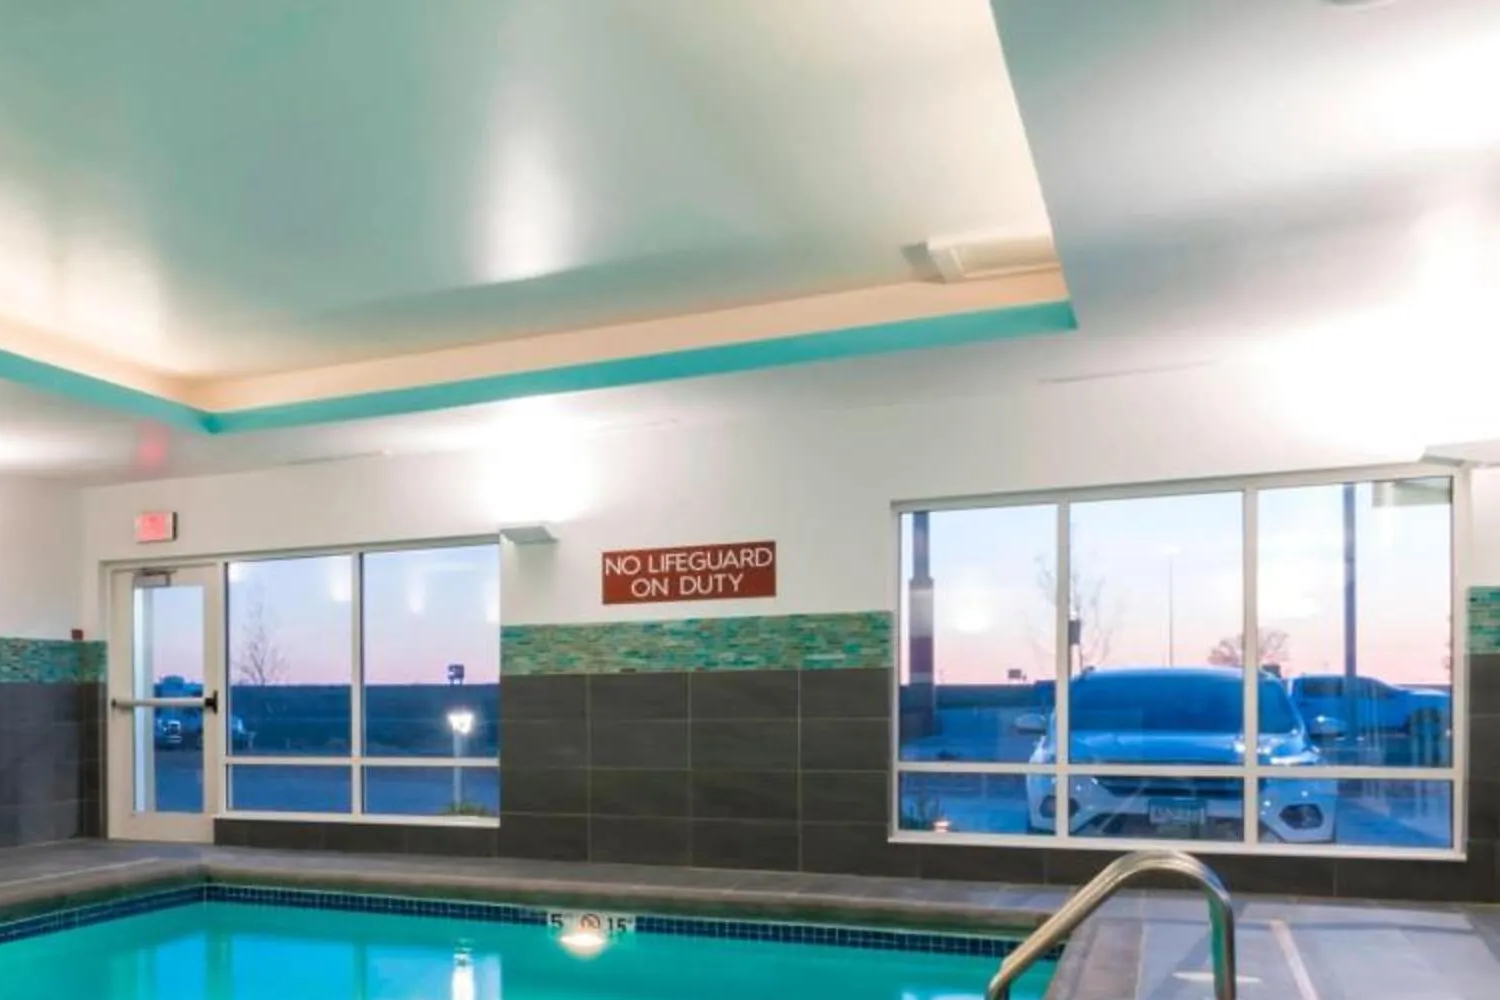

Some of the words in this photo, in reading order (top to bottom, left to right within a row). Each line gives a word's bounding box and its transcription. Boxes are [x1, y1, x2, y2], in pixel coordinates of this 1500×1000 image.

[605, 555, 641, 576] NO
[648, 547, 773, 573] LIFEGUARD
[631, 578, 670, 598] ON
[679, 573, 744, 596] DUTY
